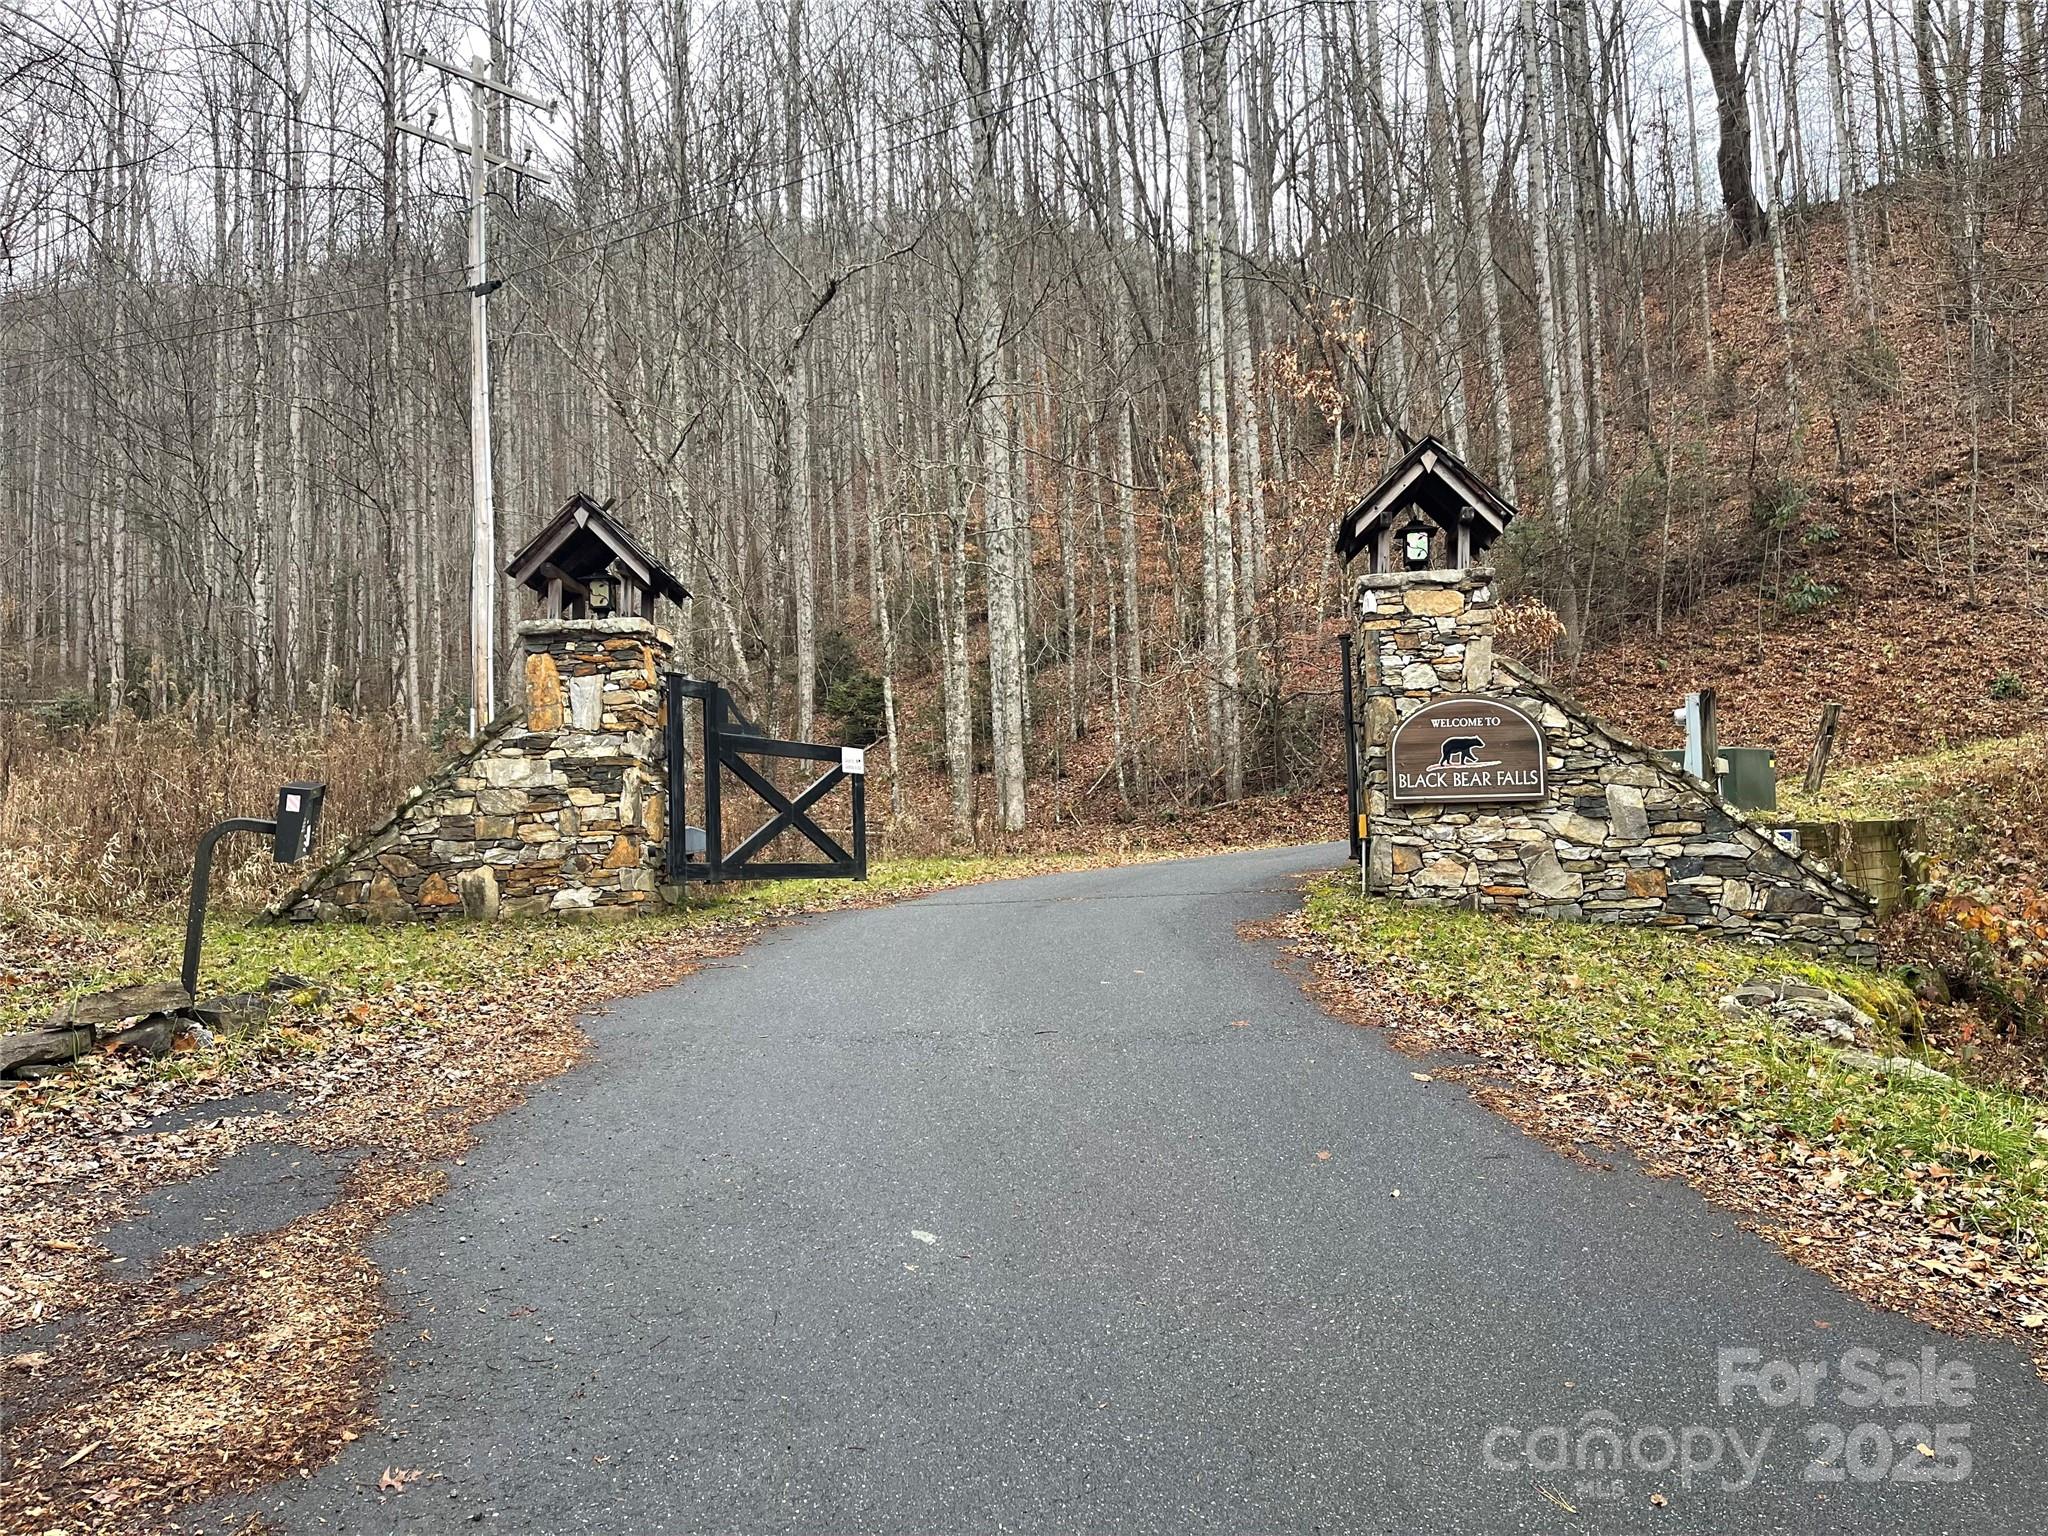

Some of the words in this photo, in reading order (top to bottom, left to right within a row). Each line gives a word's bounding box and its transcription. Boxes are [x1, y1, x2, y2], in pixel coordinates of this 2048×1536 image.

[1431, 718, 1483, 728] WELCOME
[1485, 717, 1501, 727] TO
[1399, 772, 1448, 788] BLACK
[1453, 771, 1492, 787] BEAR
[1497, 770, 1539, 785] FALLS
